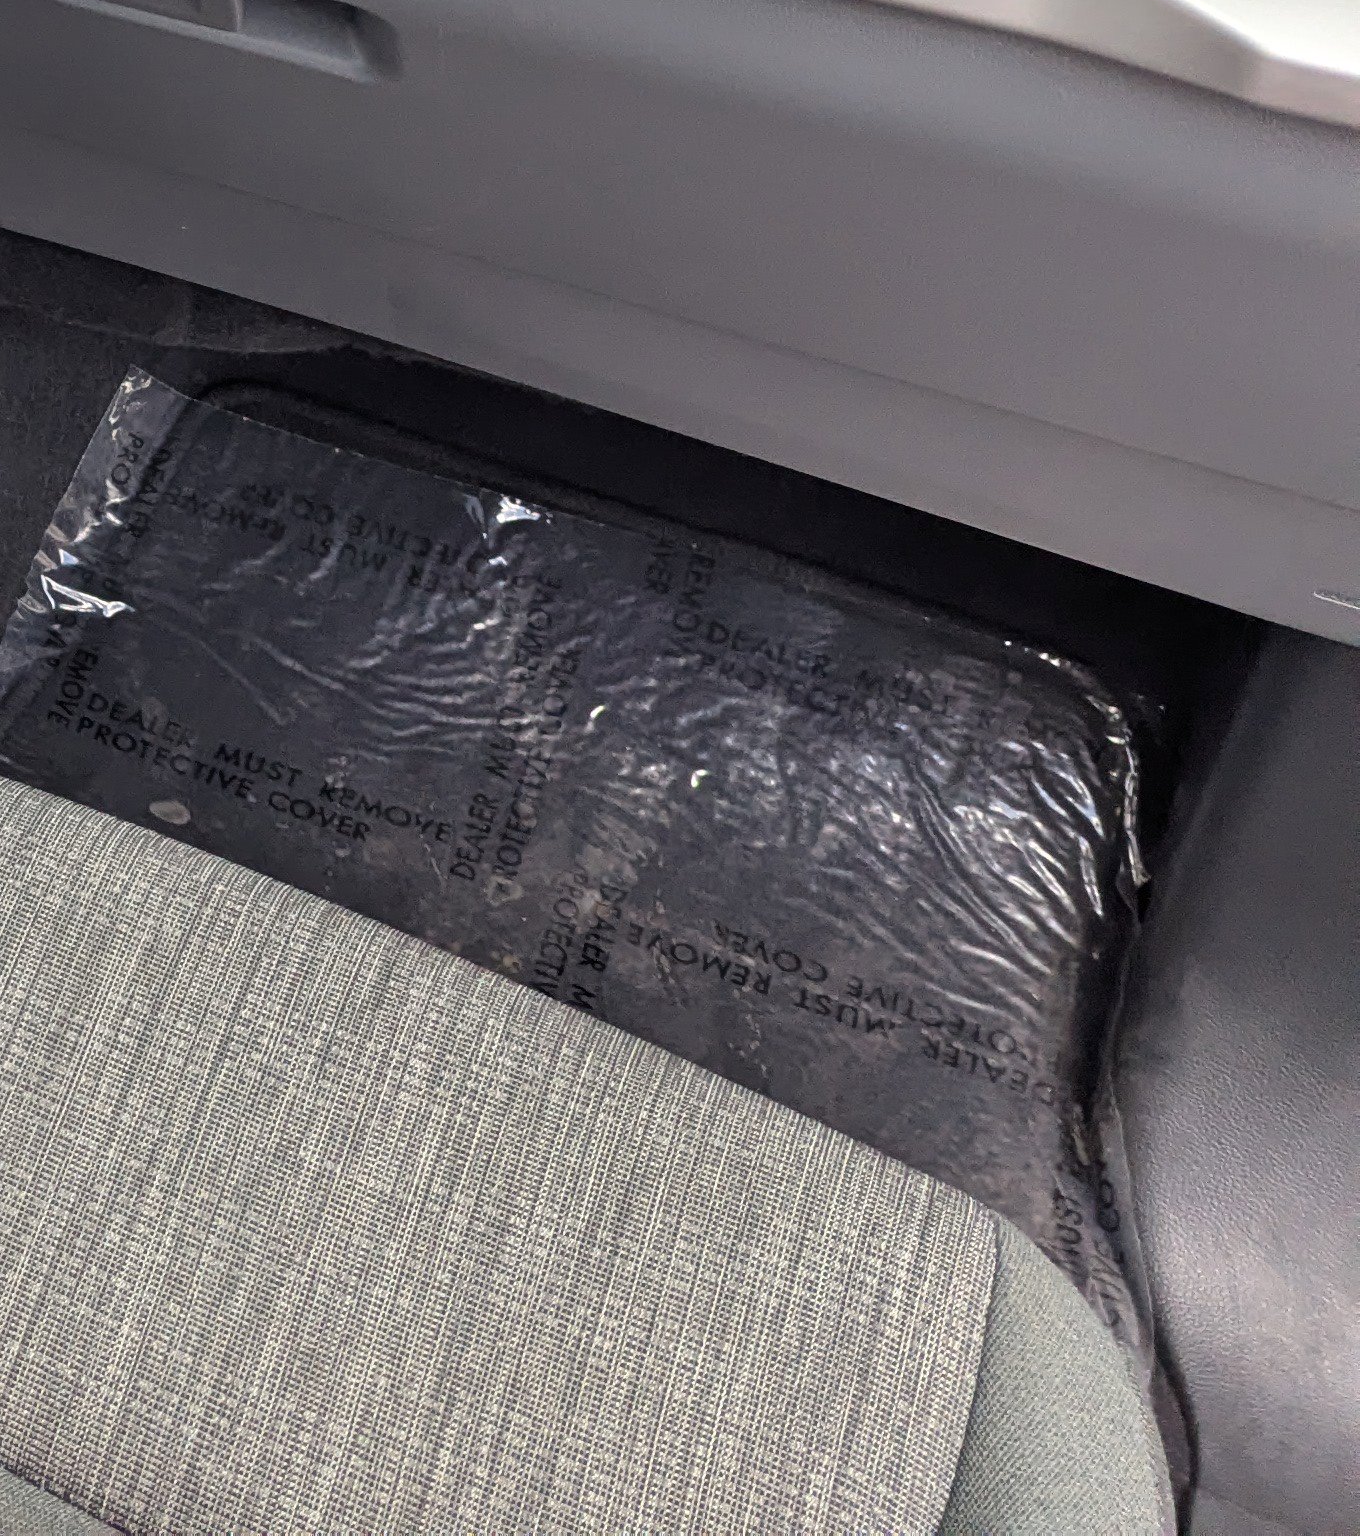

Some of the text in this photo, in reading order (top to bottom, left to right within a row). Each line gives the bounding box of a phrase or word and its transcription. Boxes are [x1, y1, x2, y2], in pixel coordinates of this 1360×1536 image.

[76, 715, 372, 842] PROTECTIVE COVER
[86, 694, 194, 749] DEALER
[214, 742, 304, 789] MUST
[448, 791, 502, 883] DEALER
[791, 987, 894, 1040] MUST
